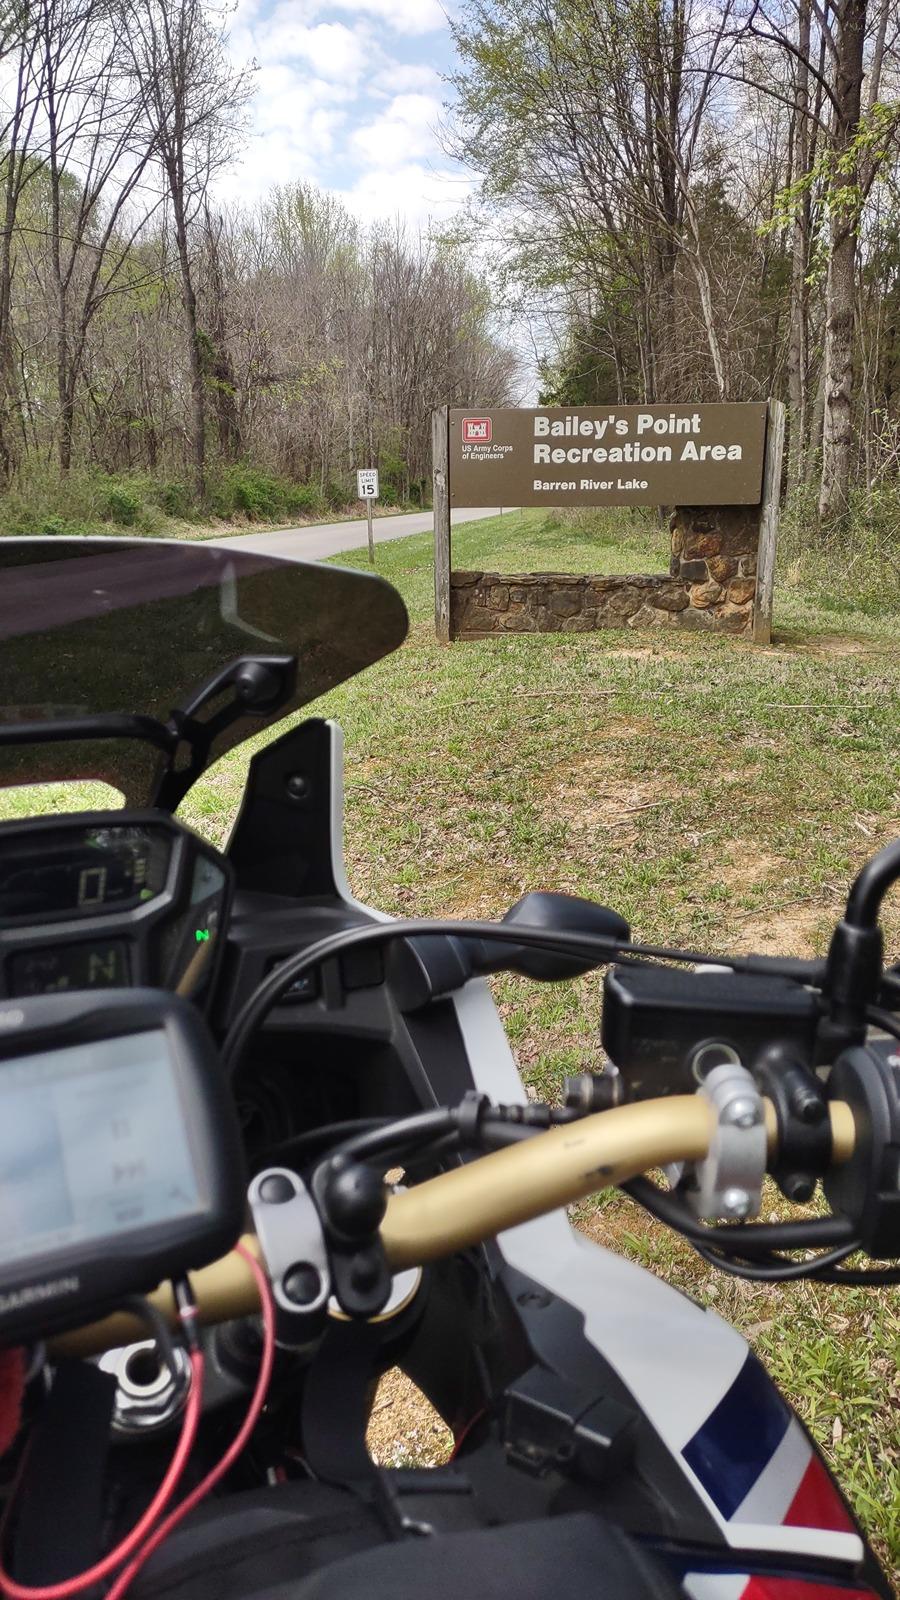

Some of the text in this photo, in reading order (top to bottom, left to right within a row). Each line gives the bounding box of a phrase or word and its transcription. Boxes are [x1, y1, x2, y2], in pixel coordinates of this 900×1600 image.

[534, 414, 702, 440] Bailey's Point
[474, 444, 492, 453] Army
[492, 444, 513, 453] Corps
[534, 441, 742, 464] Recreation Area
[470, 452, 504, 460] Engineers
[362, 484, 374, 495] 15
[534, 479, 648, 490] Barren River Lake
